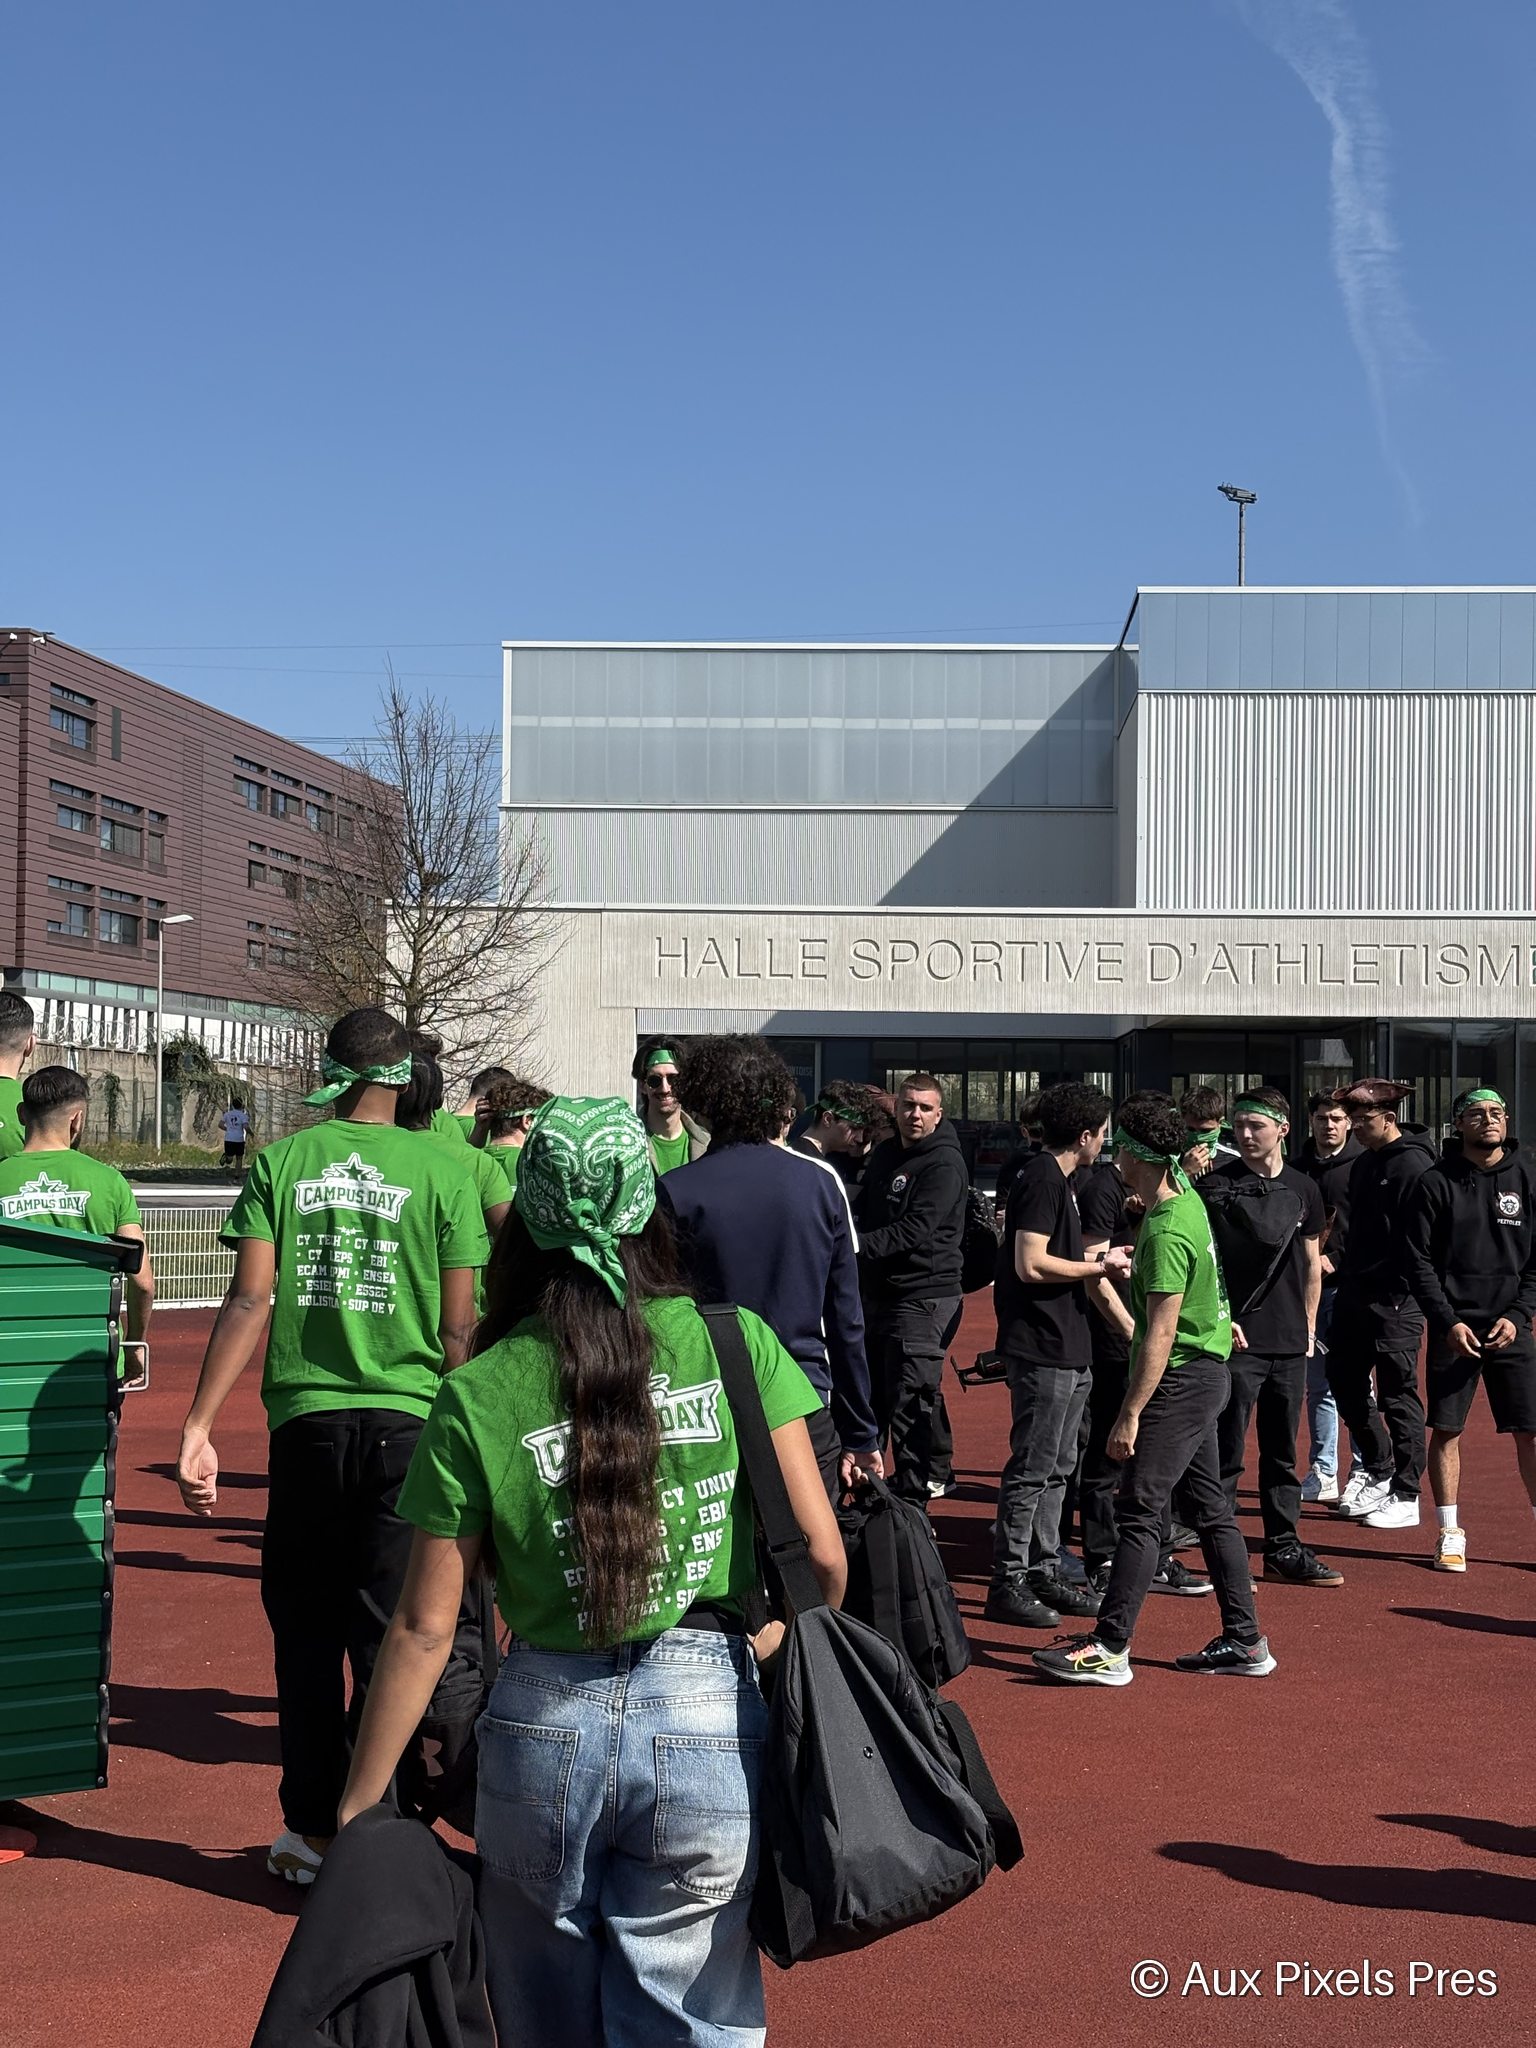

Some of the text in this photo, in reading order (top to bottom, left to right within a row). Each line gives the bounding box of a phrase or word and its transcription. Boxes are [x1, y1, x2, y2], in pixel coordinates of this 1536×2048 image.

[654, 936, 1536, 987] HALLE SPORTIVE D'ATHLETISM
[8, 1196, 83, 1215] CAMPUS DAY
[303, 1186, 398, 1212] CAMPUS DAY
[296, 1234, 311, 1246] CY
[354, 1237, 369, 1250] CY
[373, 1239, 400, 1253] UNIV
[308, 1249, 322, 1261] CY
[370, 1254, 387, 1268] EBI
[296, 1264, 327, 1277] ECAM
[363, 1269, 397, 1284] ENSEA
[355, 1283, 388, 1299] ESSEC
[348, 1298, 369, 1312] SUP
[371, 1301, 386, 1315] DE
[387, 1303, 396, 1315] V
[656, 1396, 707, 1431] DAY
[661, 1486, 685, 1510] CY
[694, 1469, 736, 1499] UNIV
[698, 1500, 727, 1527] EBI
